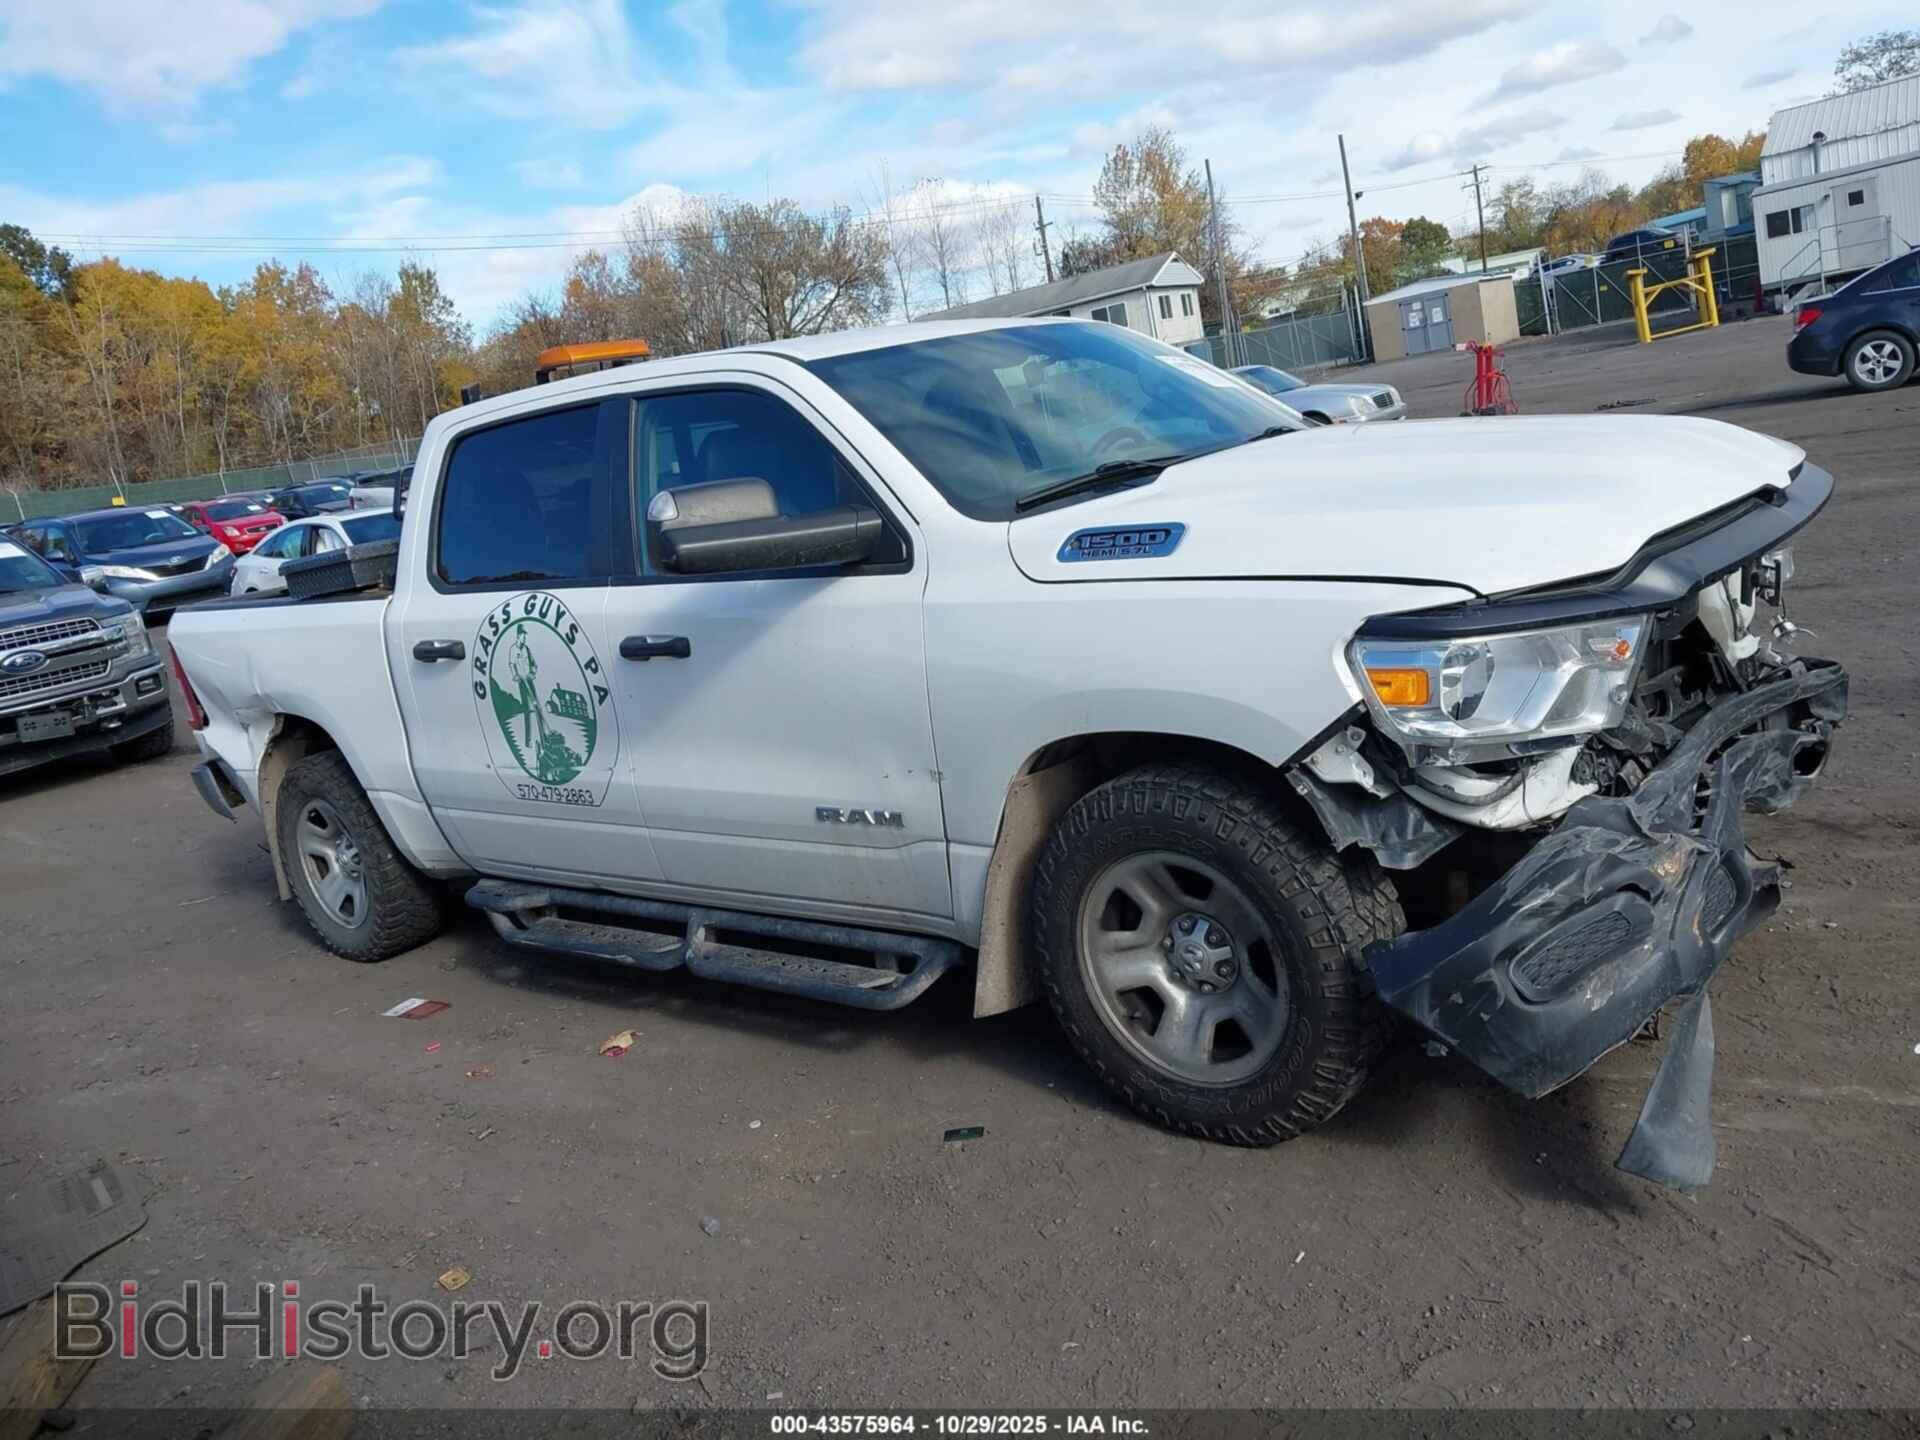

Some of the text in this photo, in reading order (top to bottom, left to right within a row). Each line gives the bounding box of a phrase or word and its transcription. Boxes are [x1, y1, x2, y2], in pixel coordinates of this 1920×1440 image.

[1080, 531, 1167, 548] 1500
[1080, 548, 1117, 559] HEMI
[474, 594, 609, 706] GRASS GUYS PA
[815, 806, 904, 828] RAM
